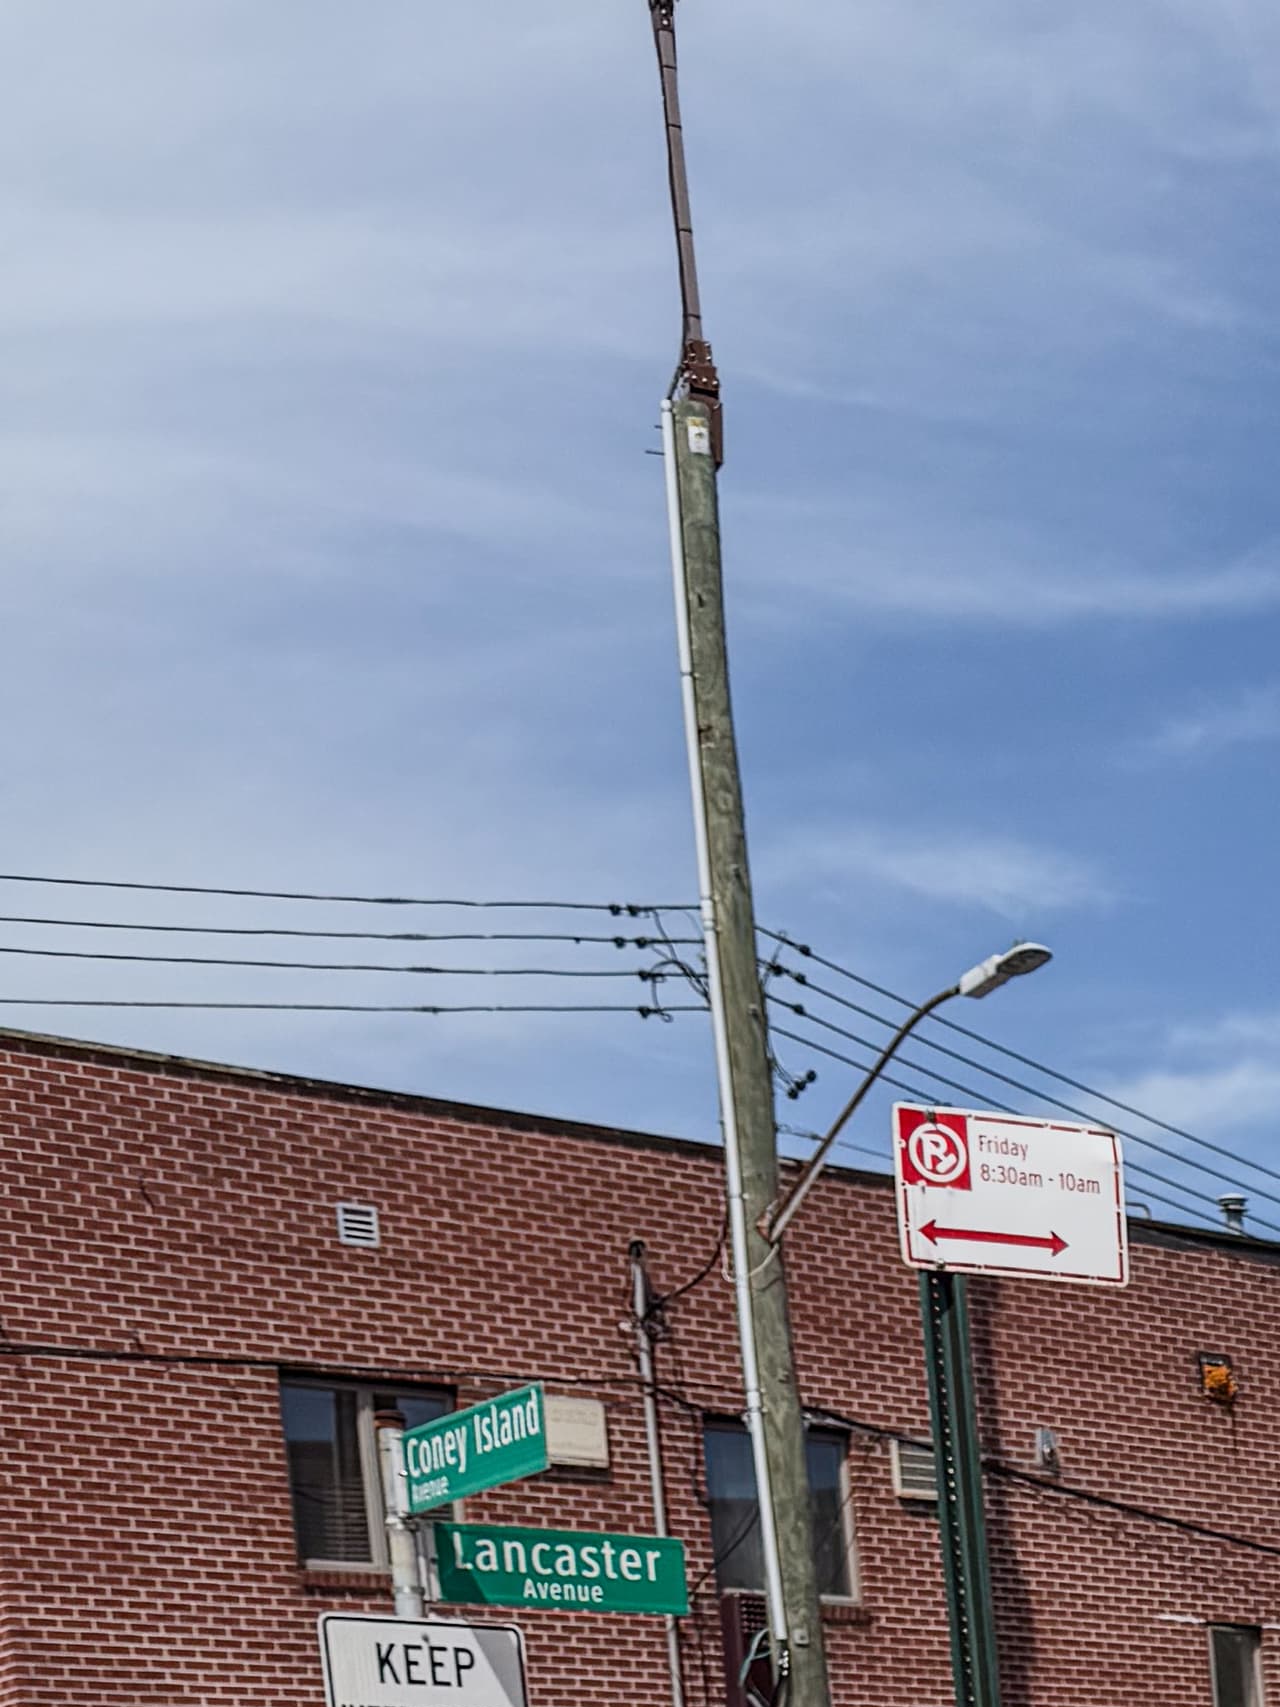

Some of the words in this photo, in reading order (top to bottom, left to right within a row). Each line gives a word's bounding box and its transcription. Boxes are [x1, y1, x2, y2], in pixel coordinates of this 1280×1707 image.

[978, 1134, 1029, 1160] Friday
[980, 1163, 1043, 1188] 8:30am
[1059, 1172, 1101, 1194] 10am
[406, 1425, 468, 1478] Coney
[474, 1389, 540, 1455] Island
[452, 1531, 662, 1582] Lancaster
[523, 1578, 604, 1603] Avenue
[375, 1641, 476, 1688] KEEP
